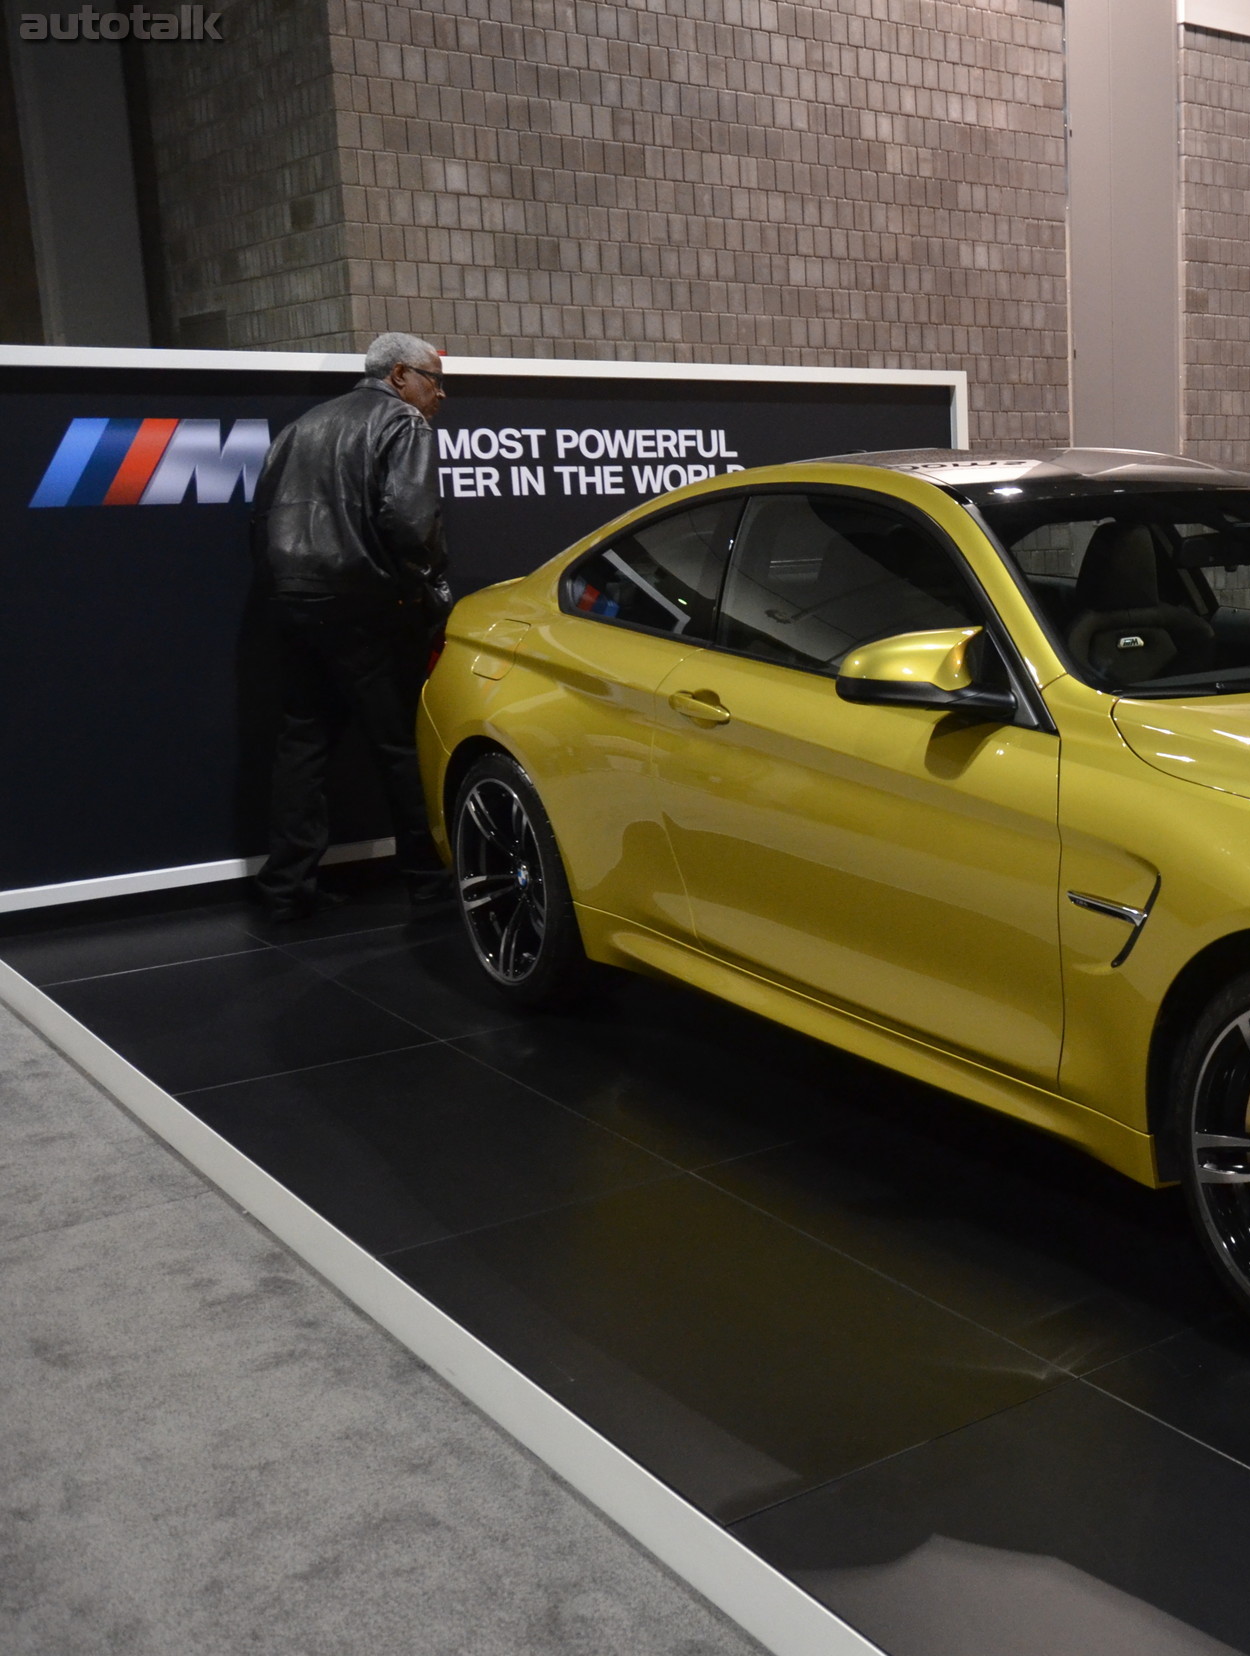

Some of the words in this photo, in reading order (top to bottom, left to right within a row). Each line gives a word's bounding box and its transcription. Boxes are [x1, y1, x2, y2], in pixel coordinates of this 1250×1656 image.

[437, 427, 546, 460] MOST
[555, 428, 738, 460] POWERFUL
[510, 465, 546, 496] IN
[553, 465, 625, 495] THE
[631, 464, 747, 494] WOR
